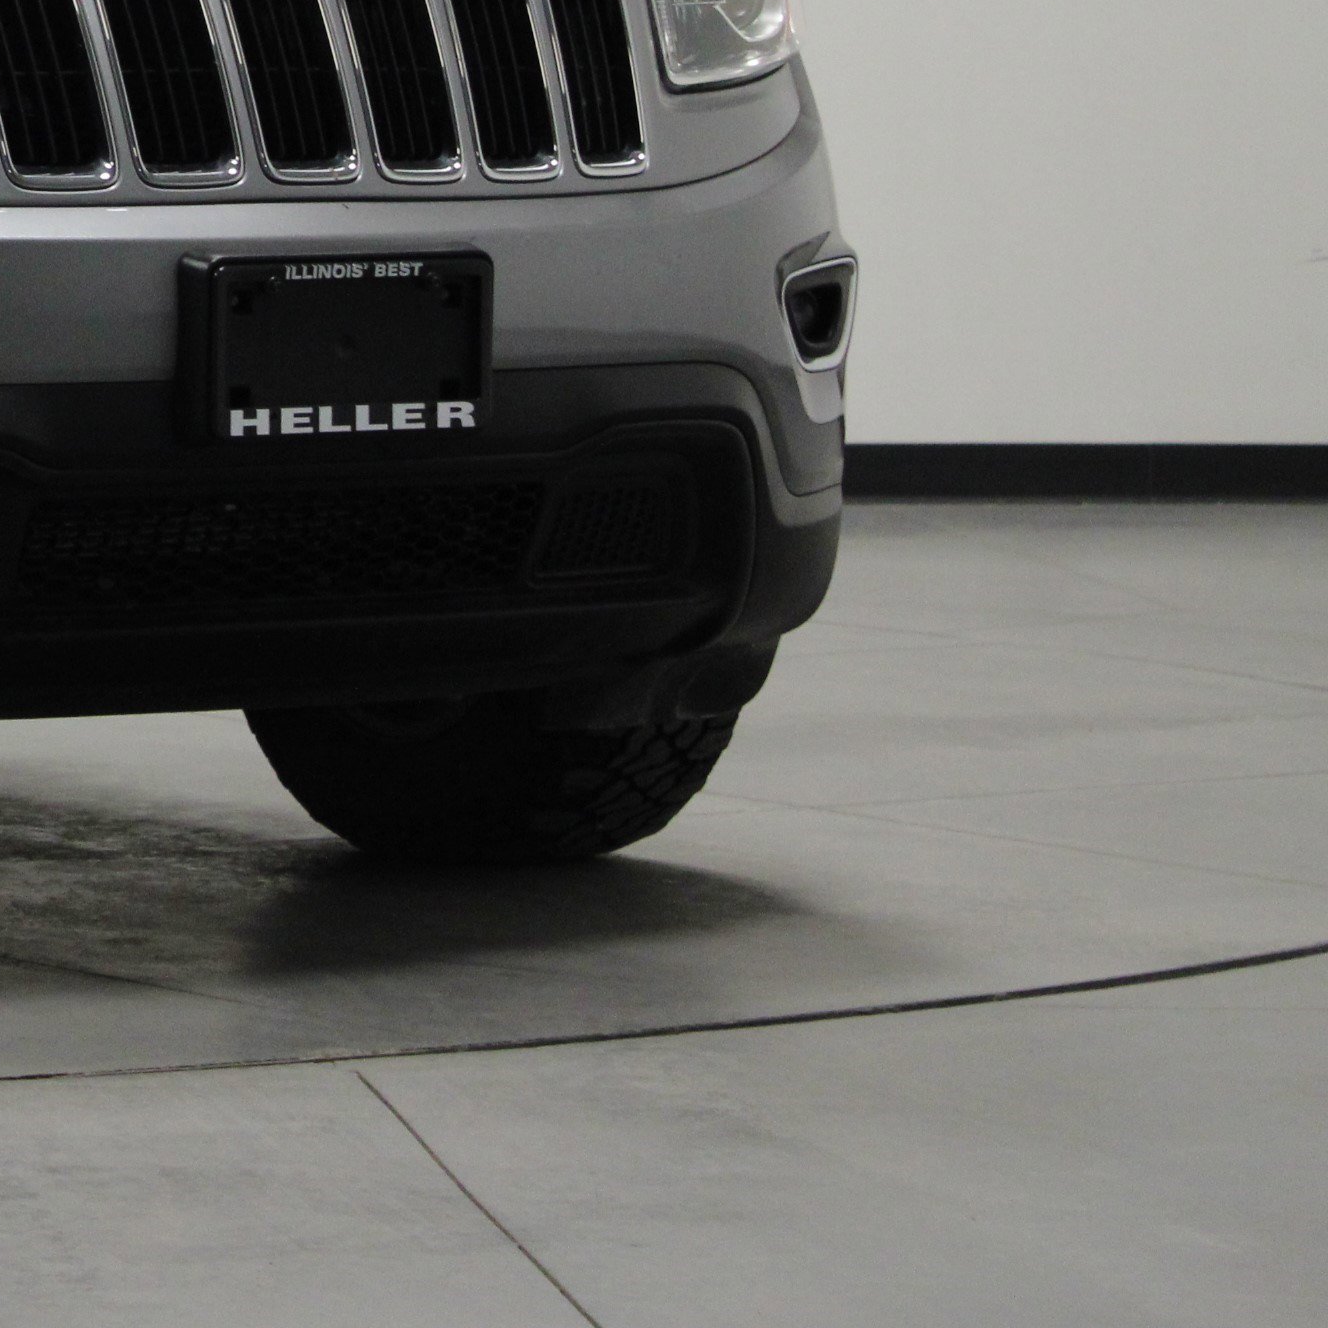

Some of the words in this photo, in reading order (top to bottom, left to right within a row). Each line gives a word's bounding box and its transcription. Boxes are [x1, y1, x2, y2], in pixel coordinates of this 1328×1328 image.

[284, 263, 369, 280] ILLINOIS'
[374, 261, 423, 277] BEST
[229, 401, 476, 437] HELLER
